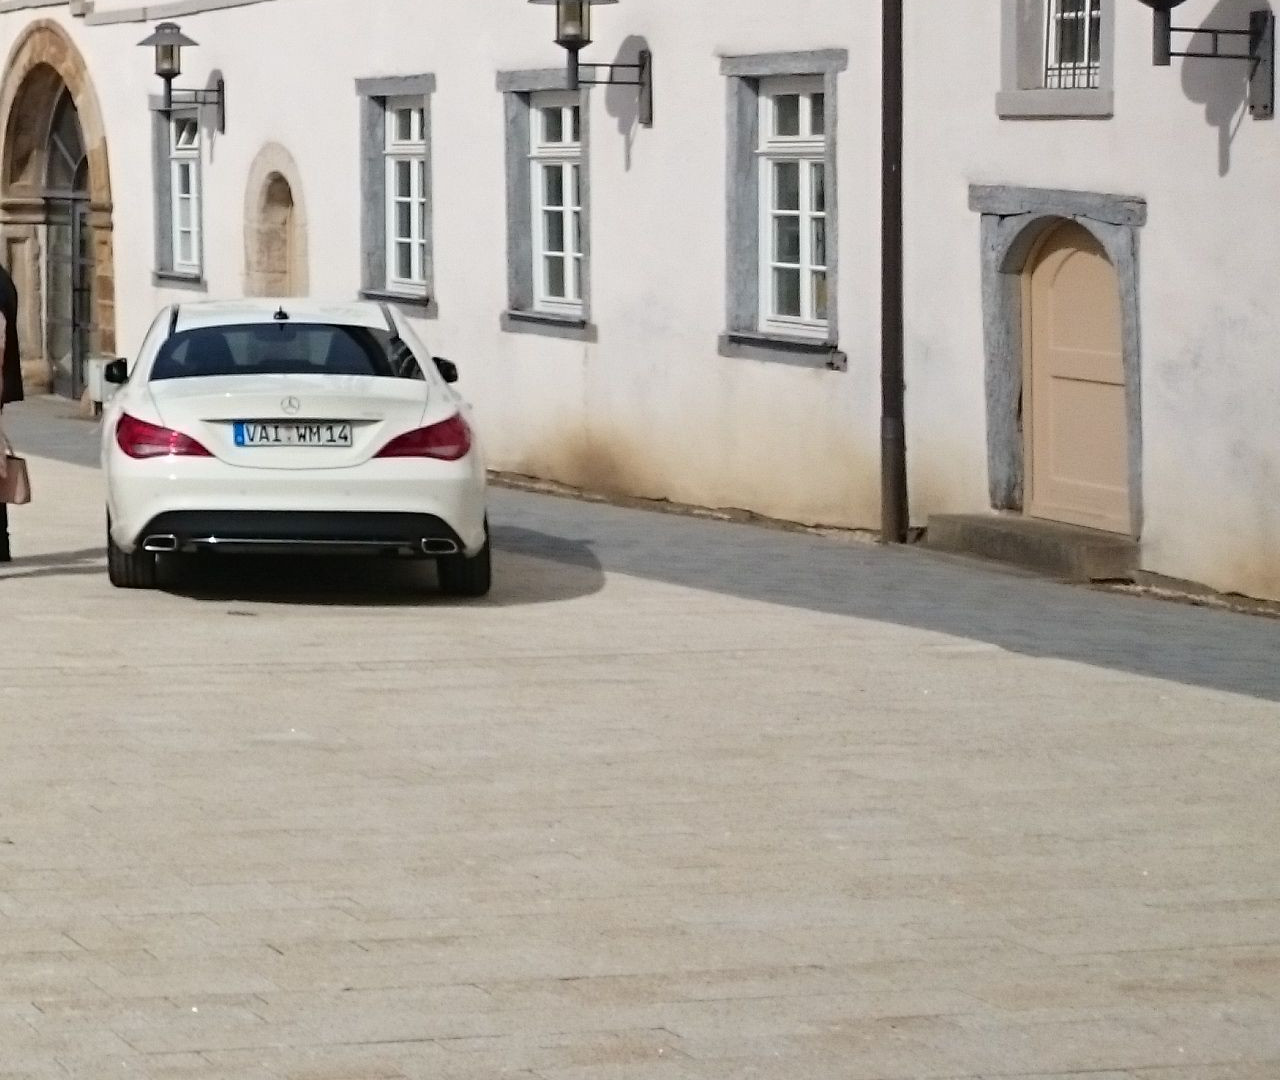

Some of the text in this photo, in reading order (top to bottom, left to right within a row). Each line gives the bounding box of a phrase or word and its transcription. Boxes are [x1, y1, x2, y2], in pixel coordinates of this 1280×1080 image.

[246, 424, 349, 442] VAI WM 14
